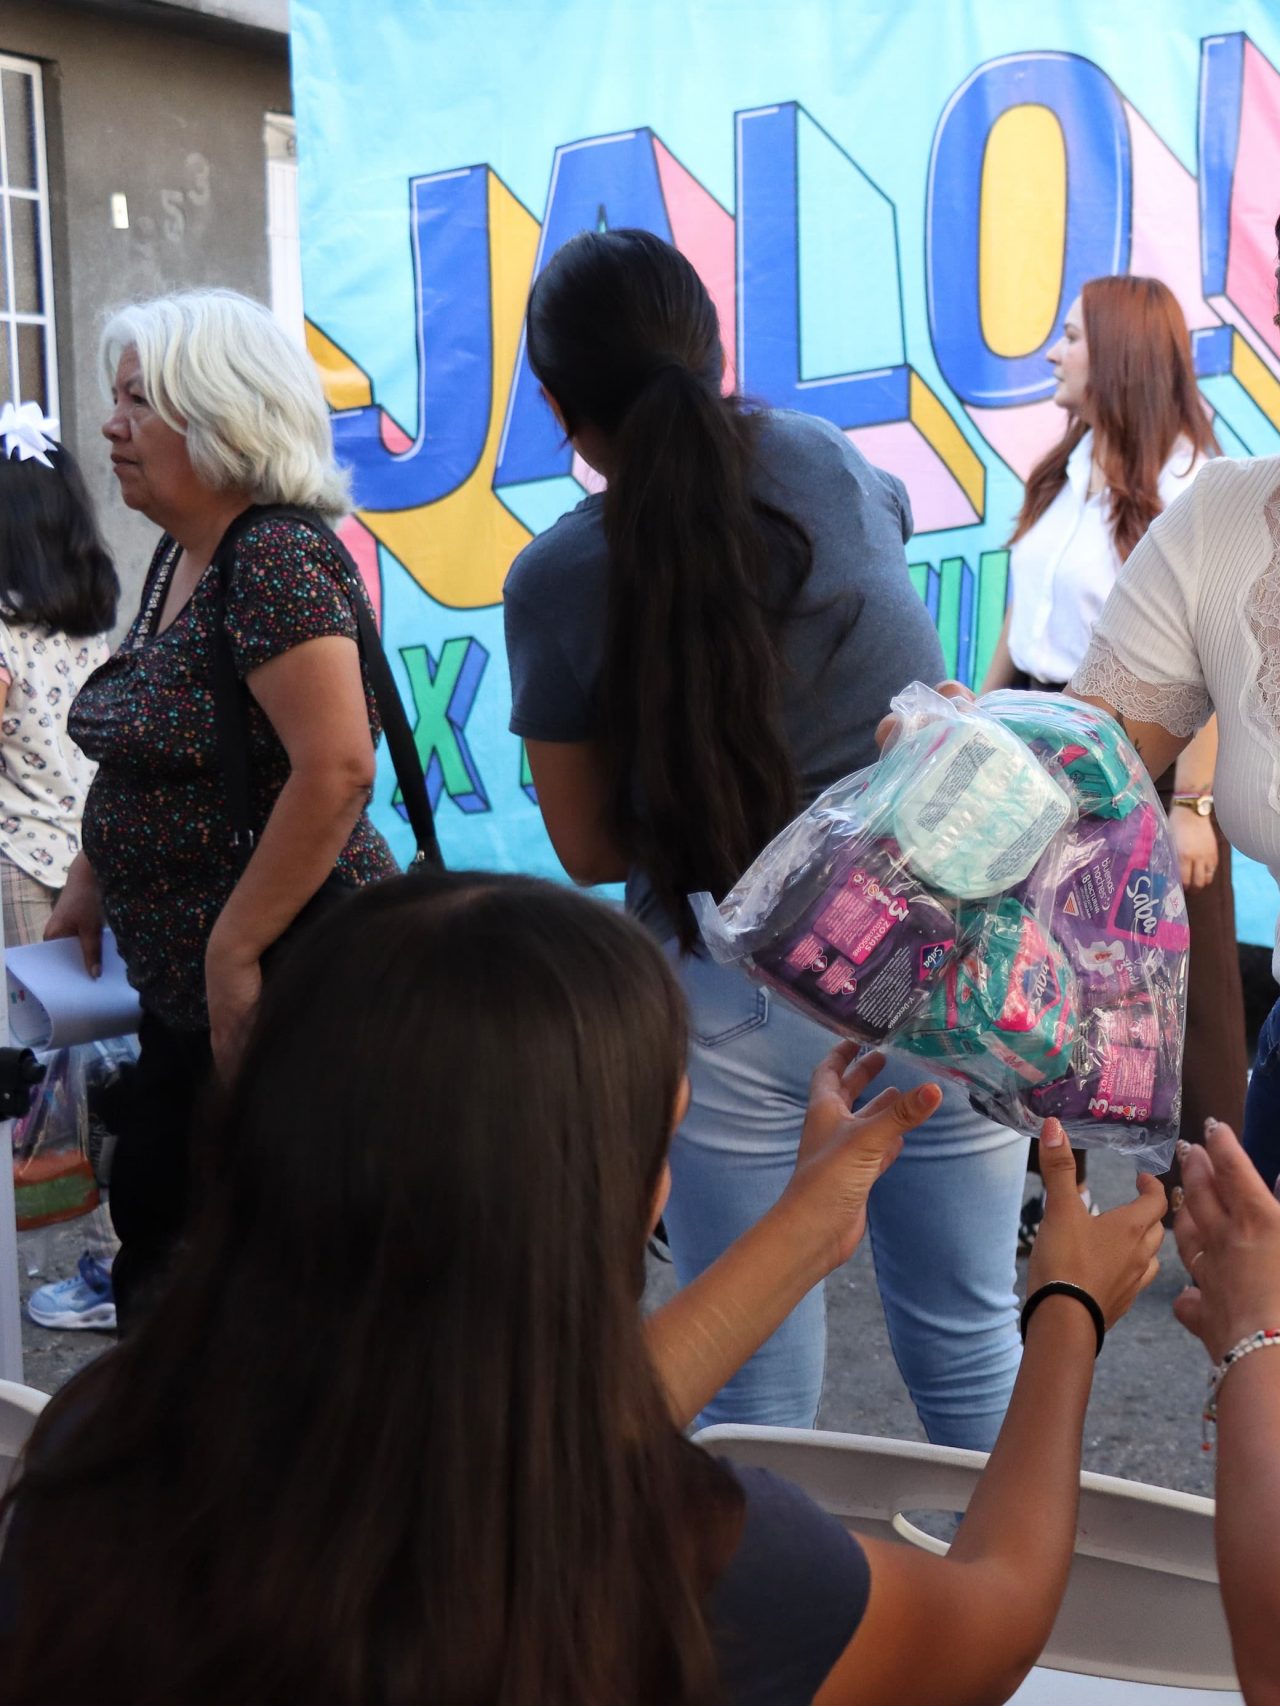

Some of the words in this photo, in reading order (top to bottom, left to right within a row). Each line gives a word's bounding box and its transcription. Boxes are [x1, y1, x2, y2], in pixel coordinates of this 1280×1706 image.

[888, 897, 910, 922] 3
[1126, 875, 1160, 934] Saba
[865, 921, 891, 952] ZONAS
[923, 945, 946, 969] Saba
